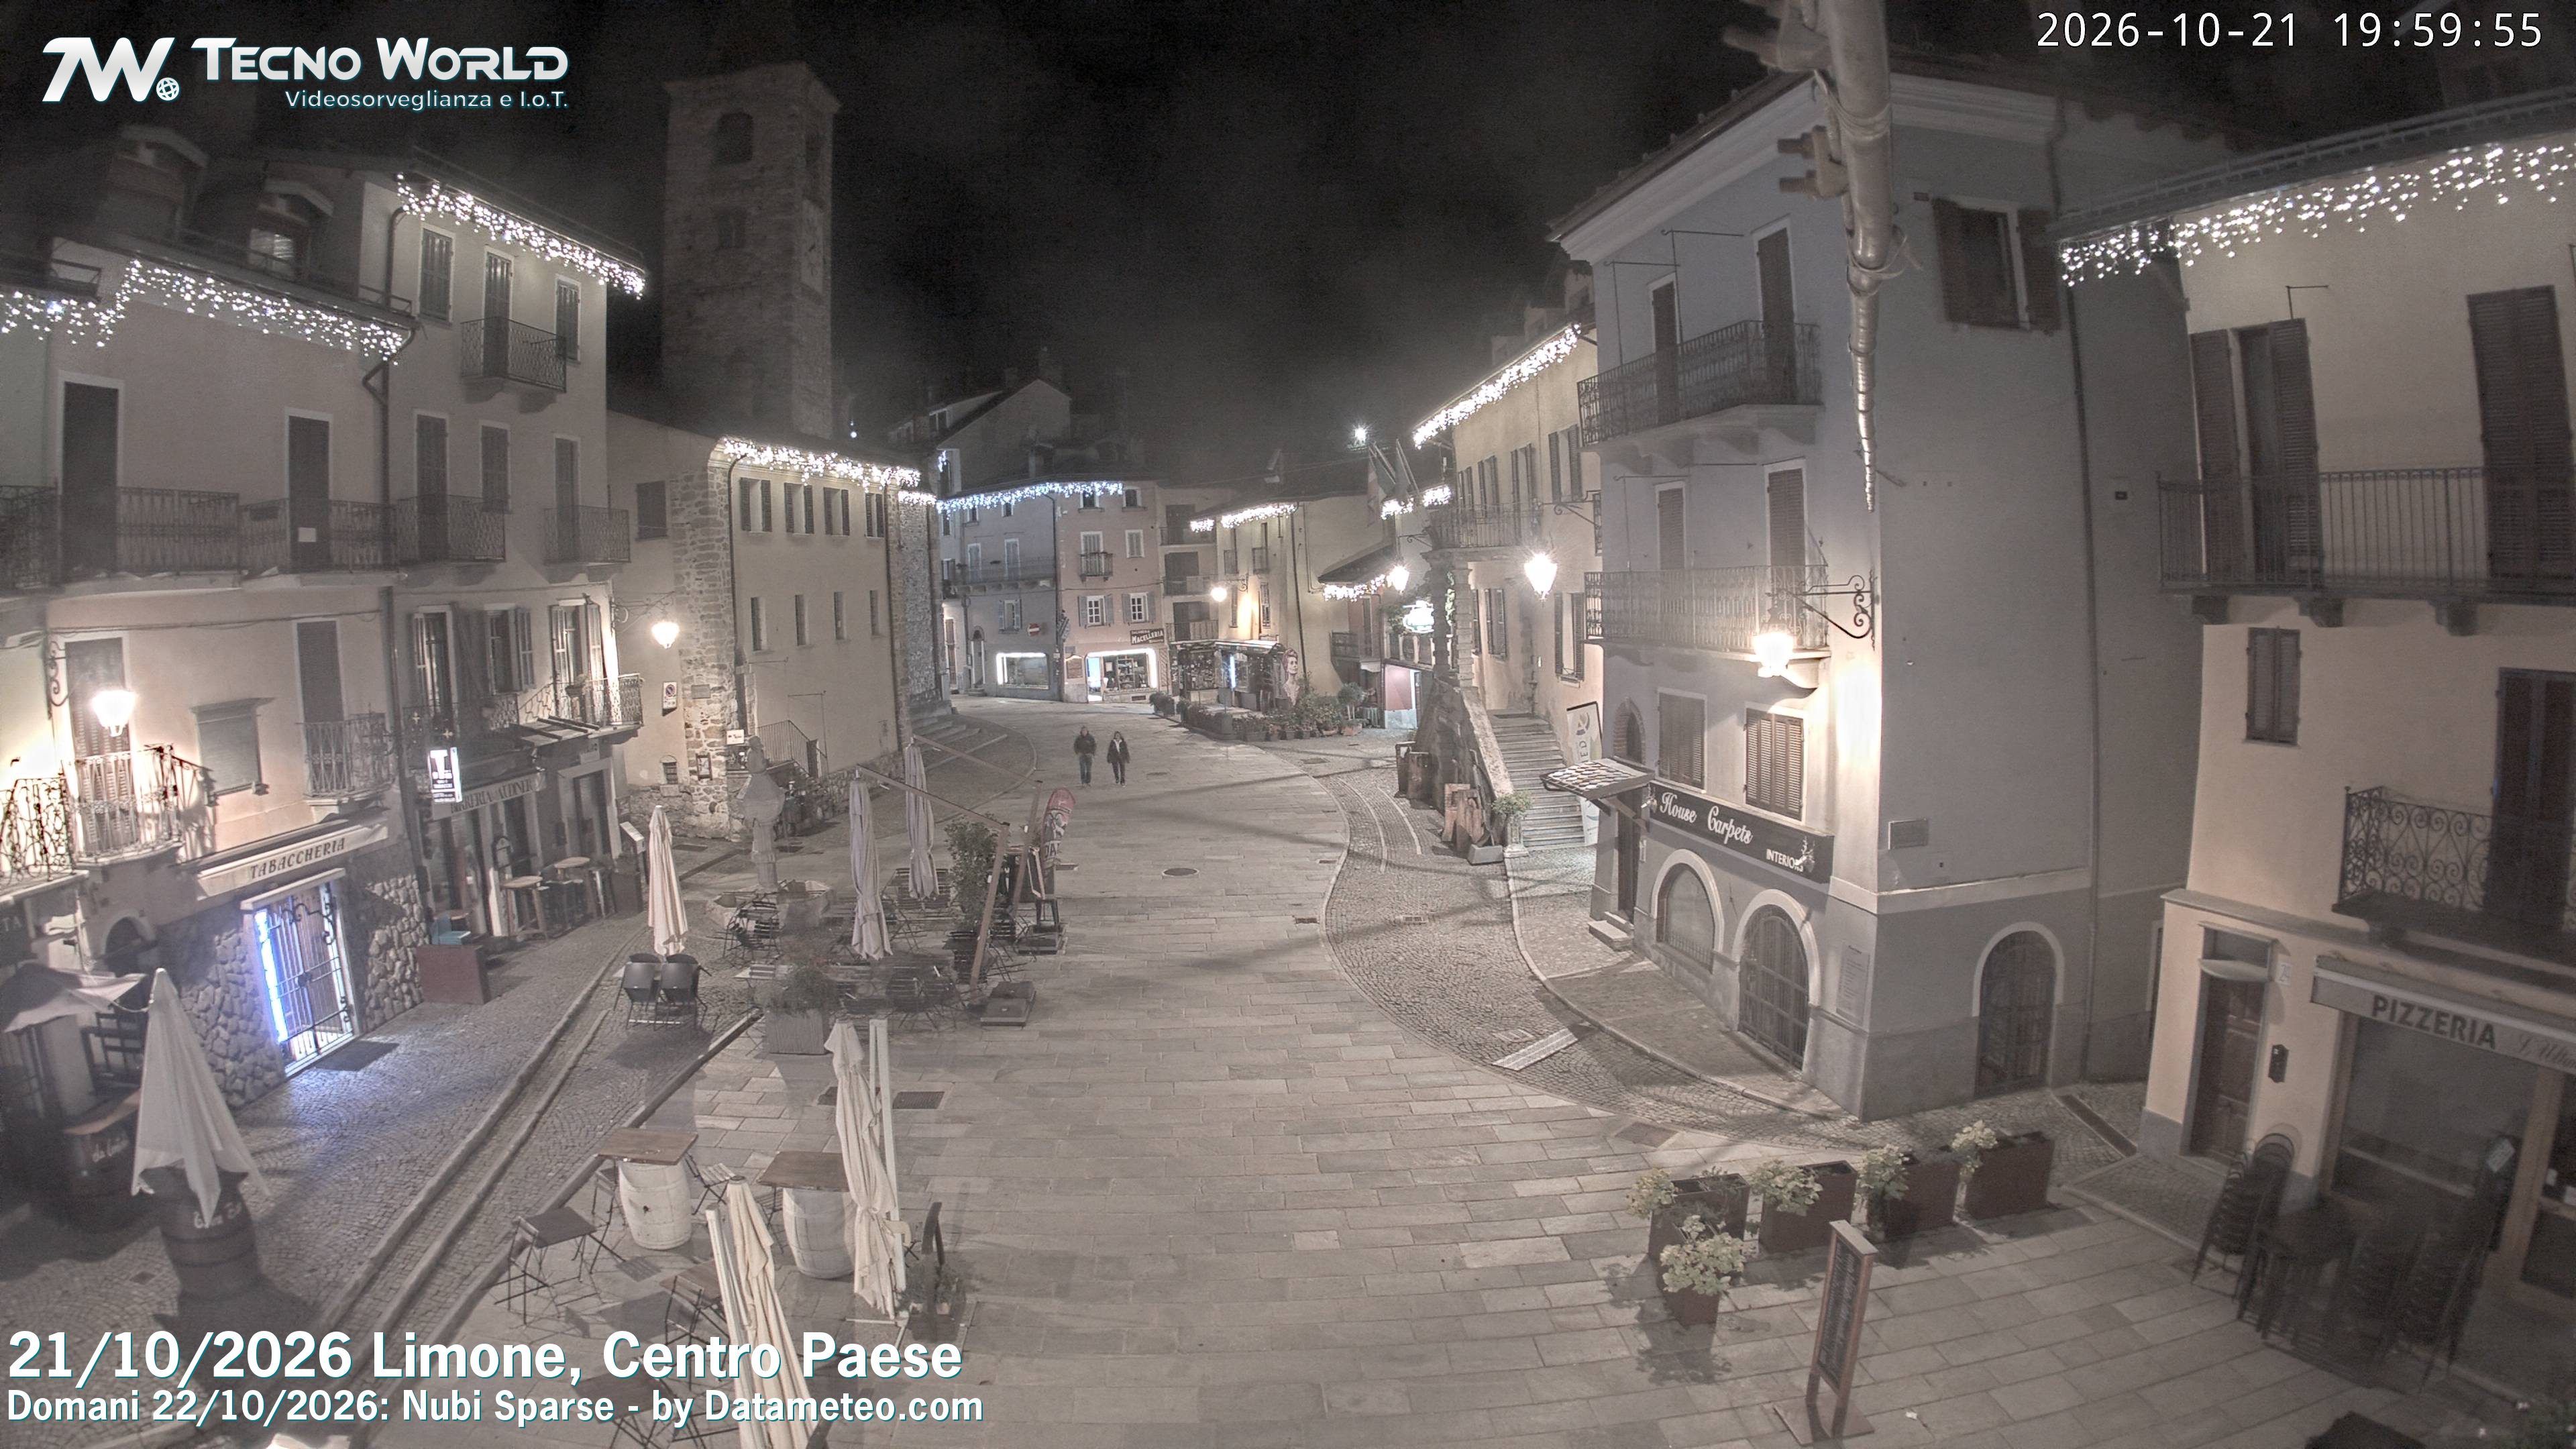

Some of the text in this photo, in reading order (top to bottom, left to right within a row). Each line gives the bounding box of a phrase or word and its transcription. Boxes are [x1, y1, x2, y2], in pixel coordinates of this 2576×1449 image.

[1659, 791, 1754, 845] House Carpets
[250, 837, 345, 879] TABACCHERIA
[2371, 994, 2496, 1050] PIZZERIA
